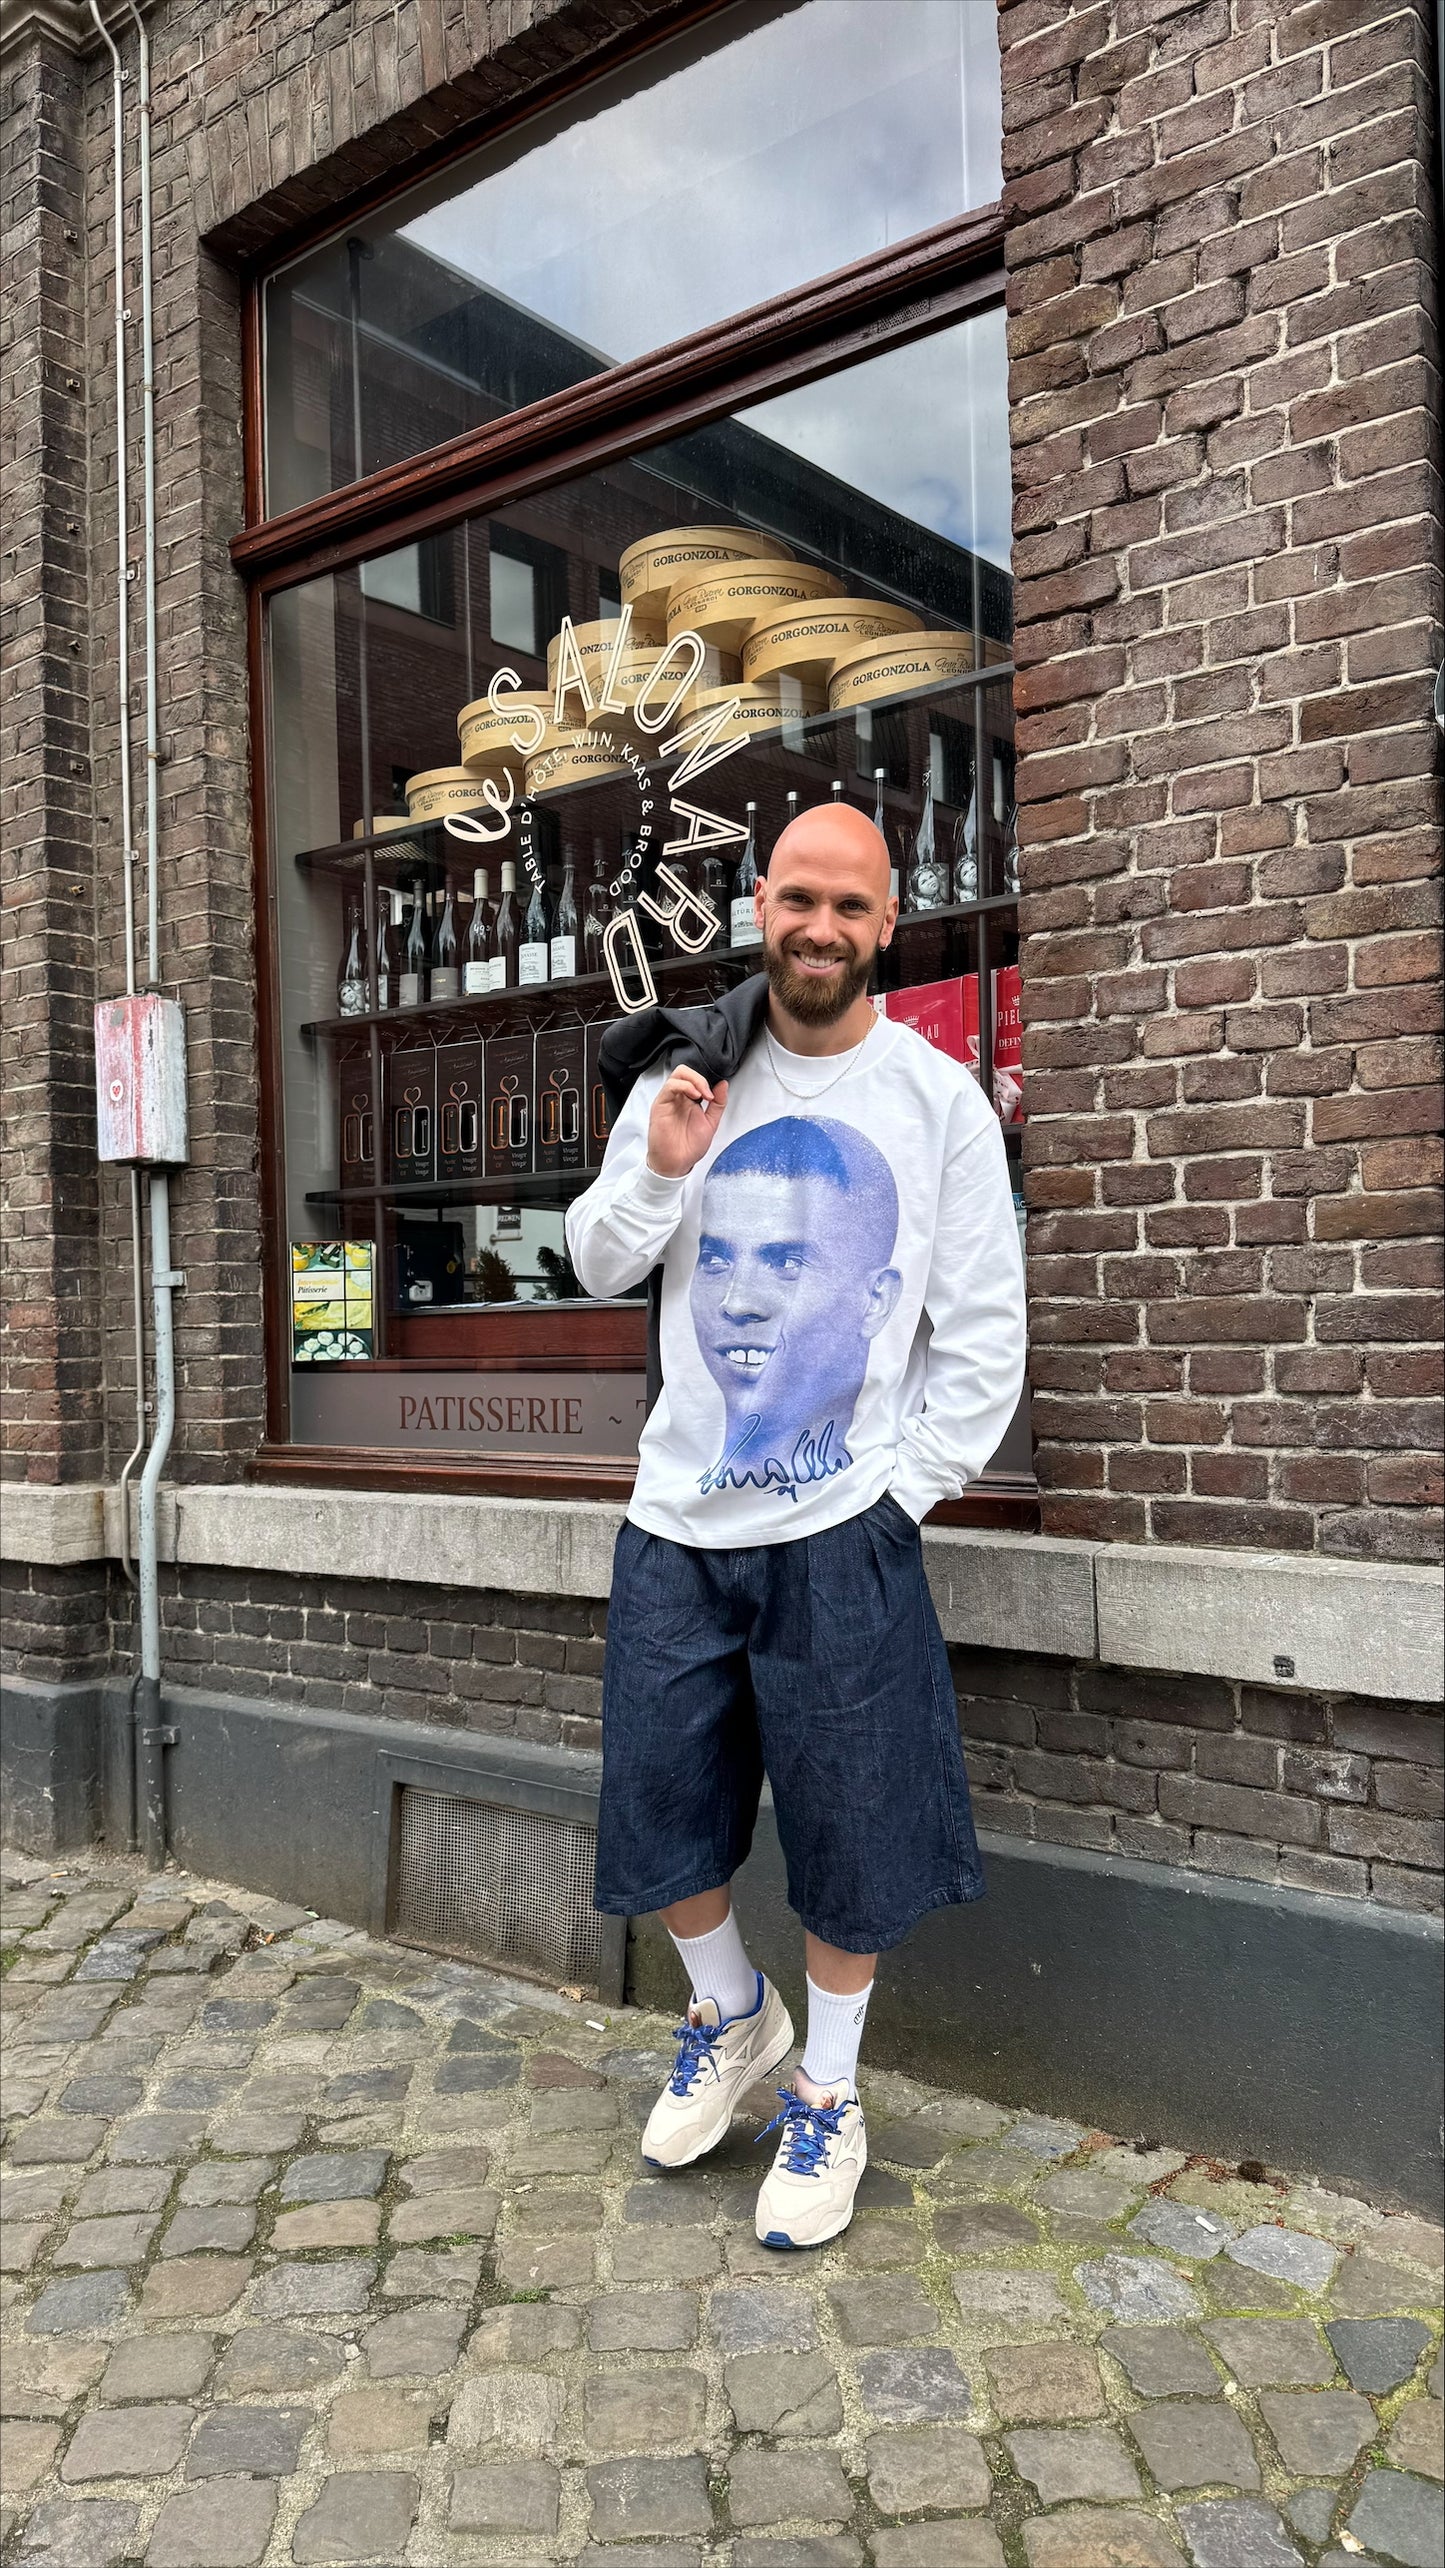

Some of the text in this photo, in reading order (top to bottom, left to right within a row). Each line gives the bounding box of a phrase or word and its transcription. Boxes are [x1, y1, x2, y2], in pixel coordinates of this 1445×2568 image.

[652, 549, 731, 568] GORGONZOLA
[727, 585, 808, 600] GORGONZOLA
[770, 622, 851, 644] GORGONZOLA
[852, 661, 932, 687] GORGONZOLA
[571, 731, 616, 753] WIJN,
[620, 743, 651, 791] KAAS
[487, 603, 750, 1014] SALONARD
[641, 799, 654, 817] &
[520, 834, 546, 895] TABLE
[609, 825, 653, 897] BROOD
[399, 1395, 584, 1435] PATISSERIE
